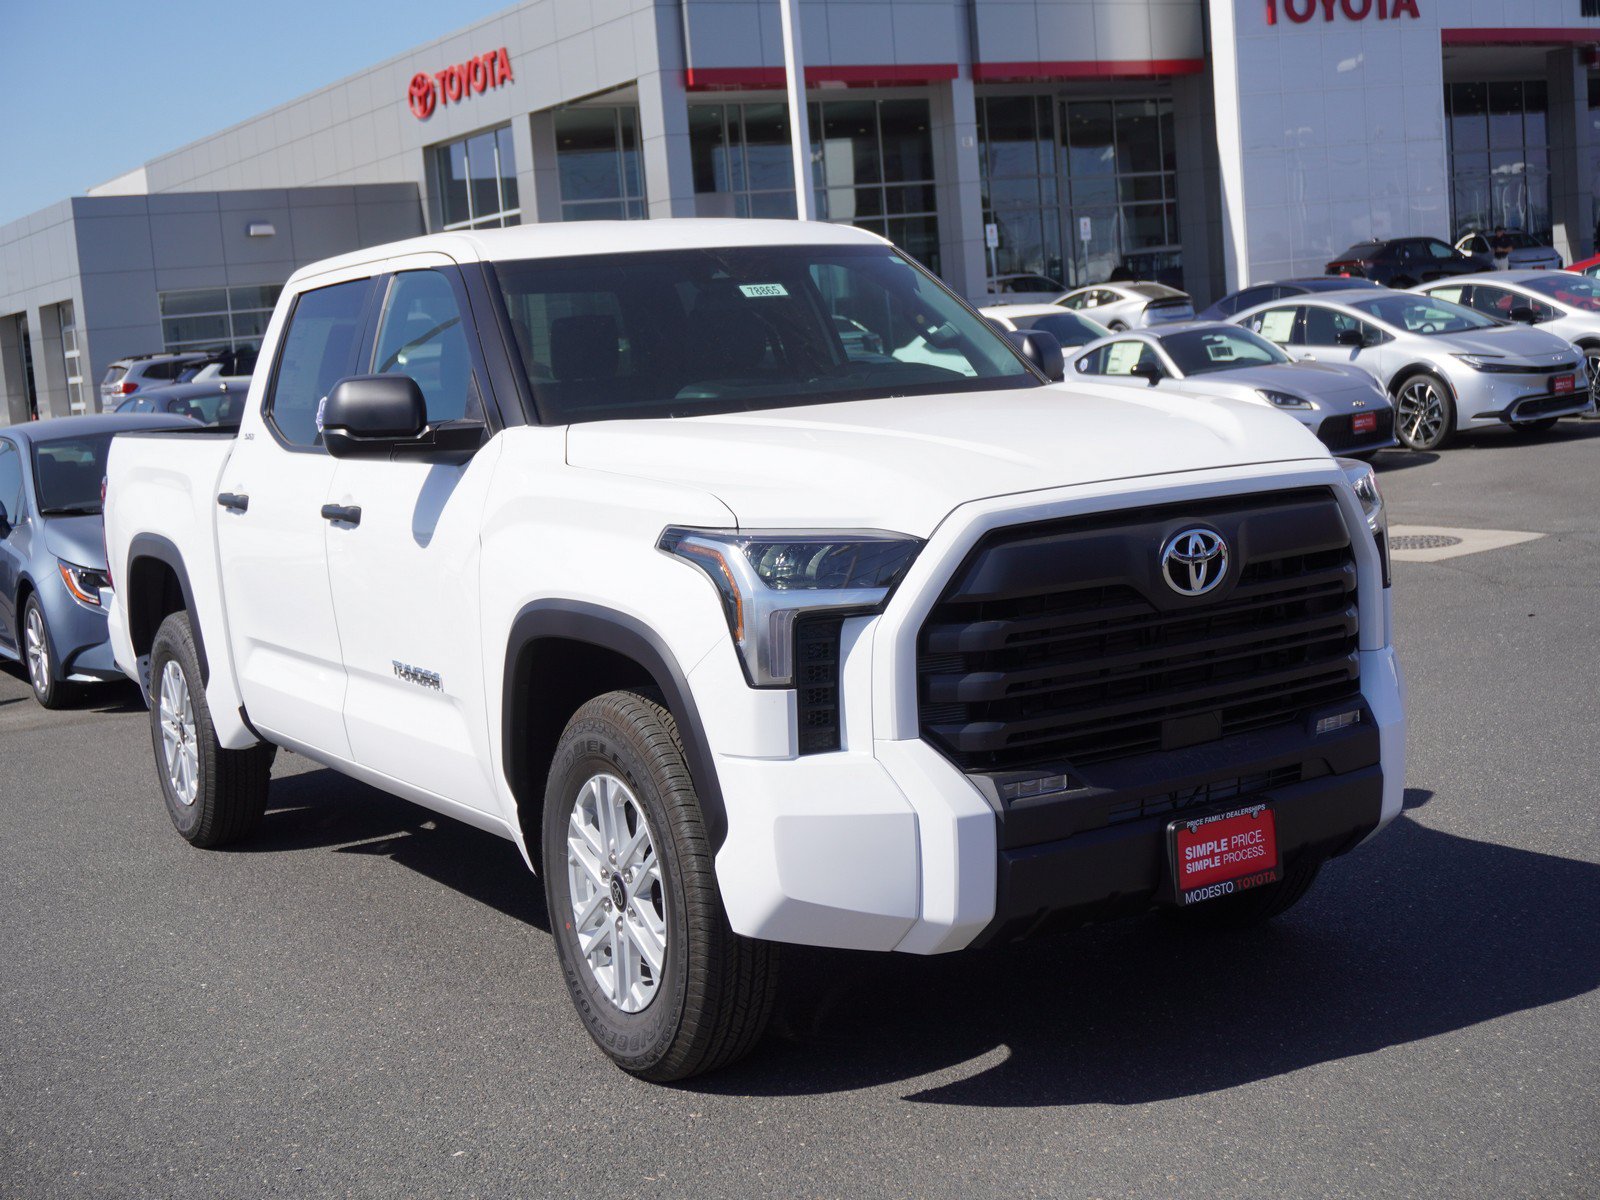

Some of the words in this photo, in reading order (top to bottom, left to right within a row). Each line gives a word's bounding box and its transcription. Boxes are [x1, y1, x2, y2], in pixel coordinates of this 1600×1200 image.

[434, 47, 513, 106] TOYOTA
[746, 285, 781, 296] 78865
[1186, 818, 1204, 829] PRICE
[1204, 813, 1226, 825] FAMILY
[1226, 803, 1266, 819] DEALERSHIPS
[1185, 838, 1229, 861] SIMPLE
[1231, 829, 1266, 849] PRICE.
[1186, 856, 1222, 874] SIMPLE
[1223, 845, 1267, 865] PROCESS.
[1185, 881, 1235, 904] MODESTO
[1236, 871, 1277, 890] TOYOTA
